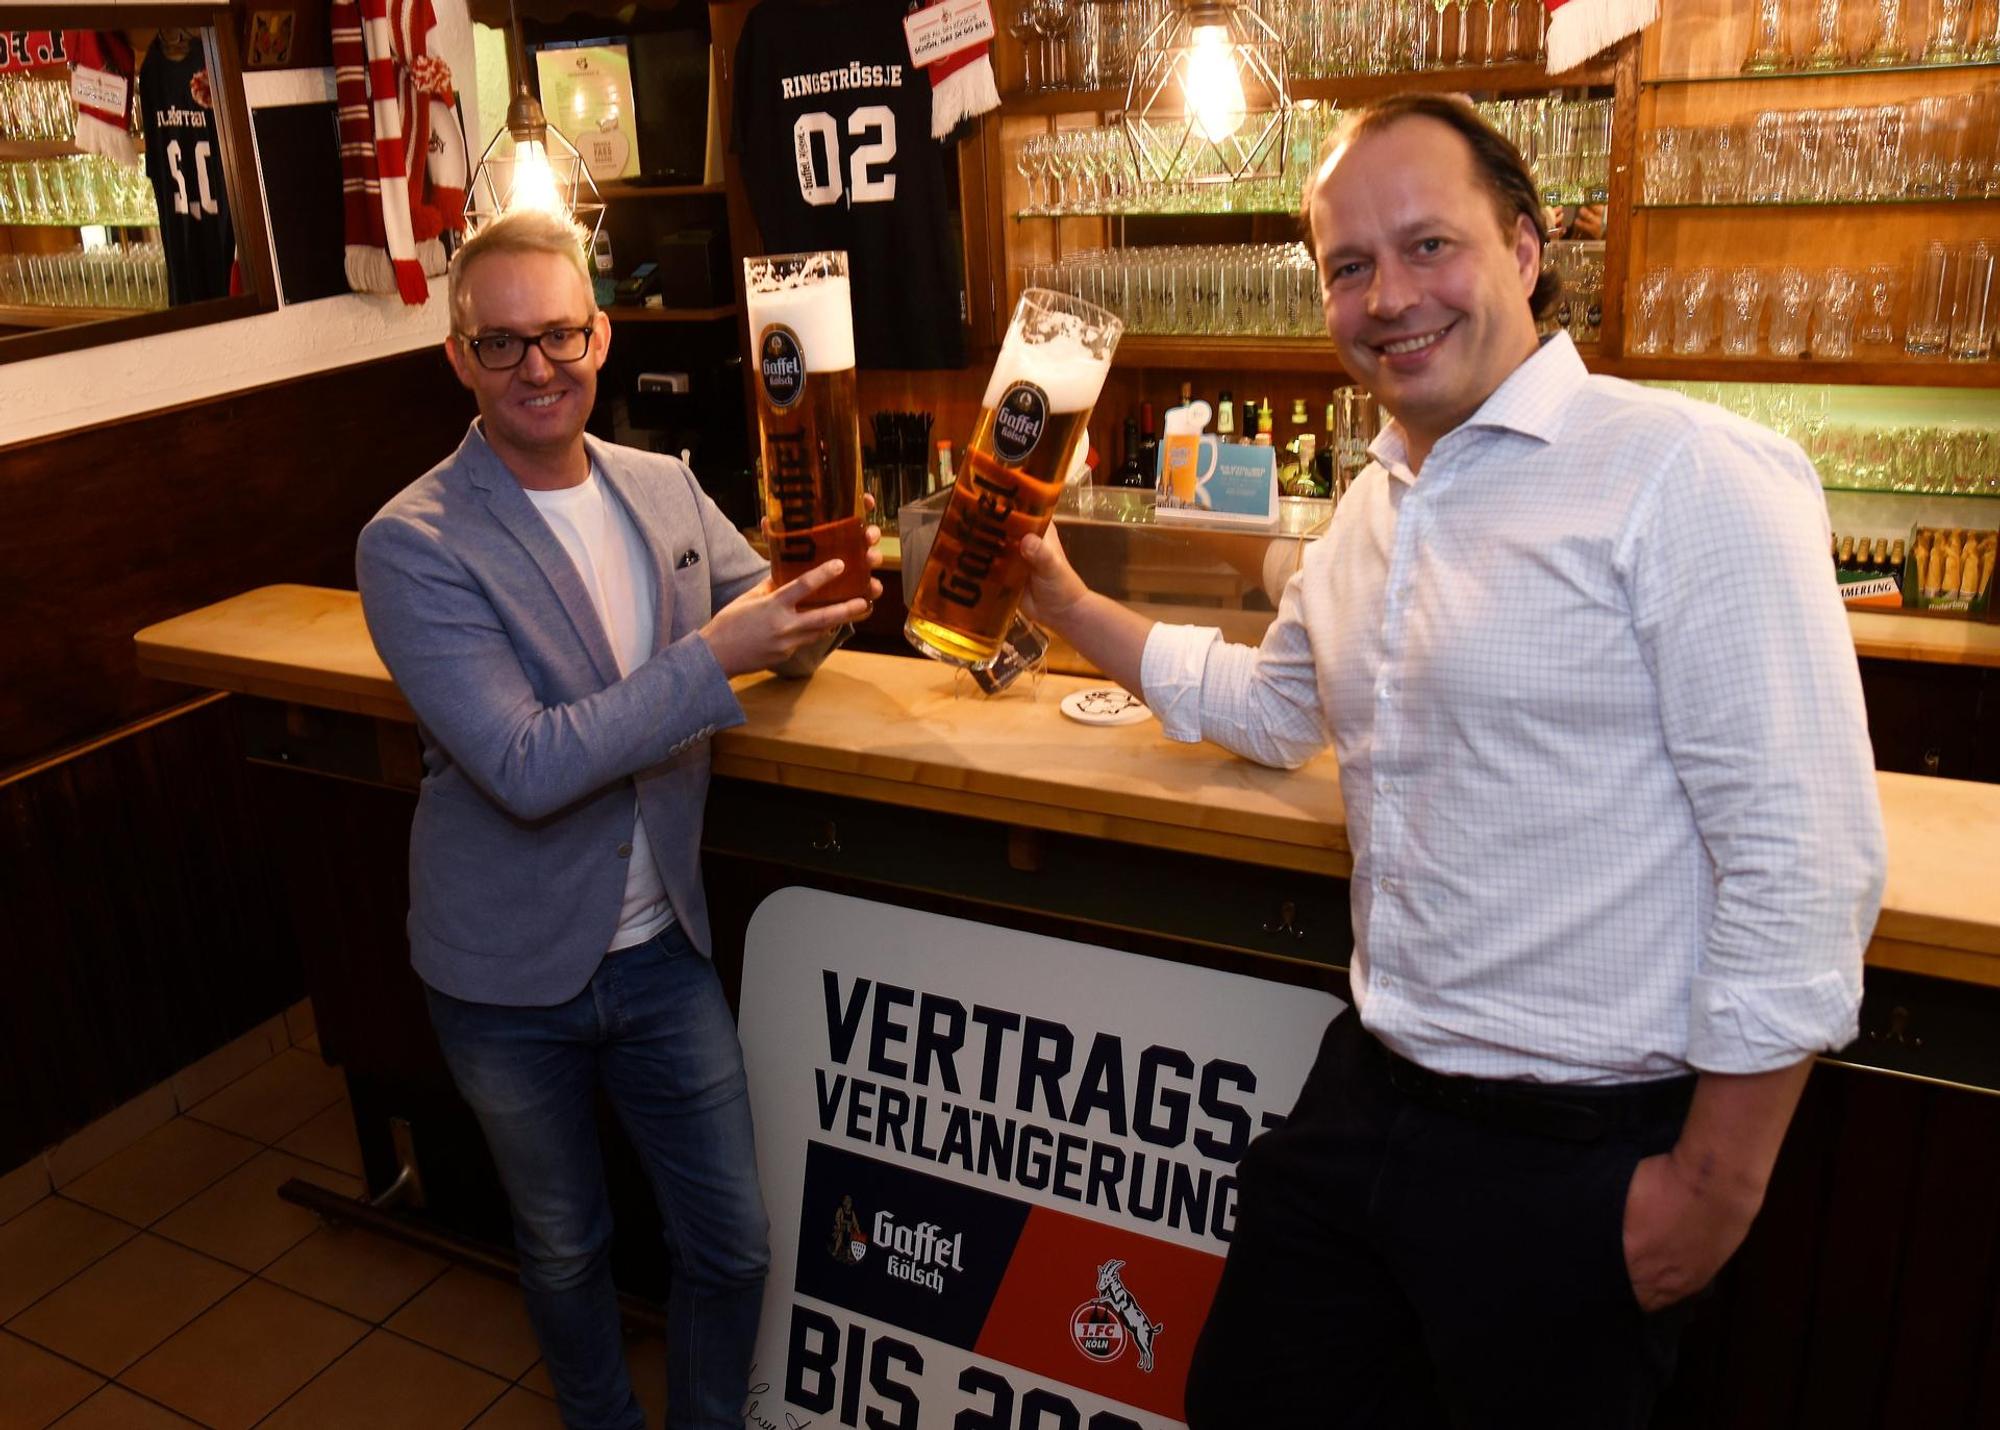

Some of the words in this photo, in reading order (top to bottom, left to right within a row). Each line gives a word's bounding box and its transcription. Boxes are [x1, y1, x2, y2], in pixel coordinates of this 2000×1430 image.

[781, 60, 902, 99] RINGSTRÖSSJE
[793, 105, 897, 207] 02
[763, 357, 800, 376] Gaffel
[999, 407, 1040, 437] Gaffel
[822, 969, 1288, 1164] VERTRAGS-
[814, 1067, 1238, 1243] VERLÄNGERUNG
[873, 1210, 964, 1272] Gaffel
[887, 1255, 944, 1294] Kölsch
[1082, 1324, 1115, 1337] 1.FC
[784, 1303, 924, 1430] BIS
